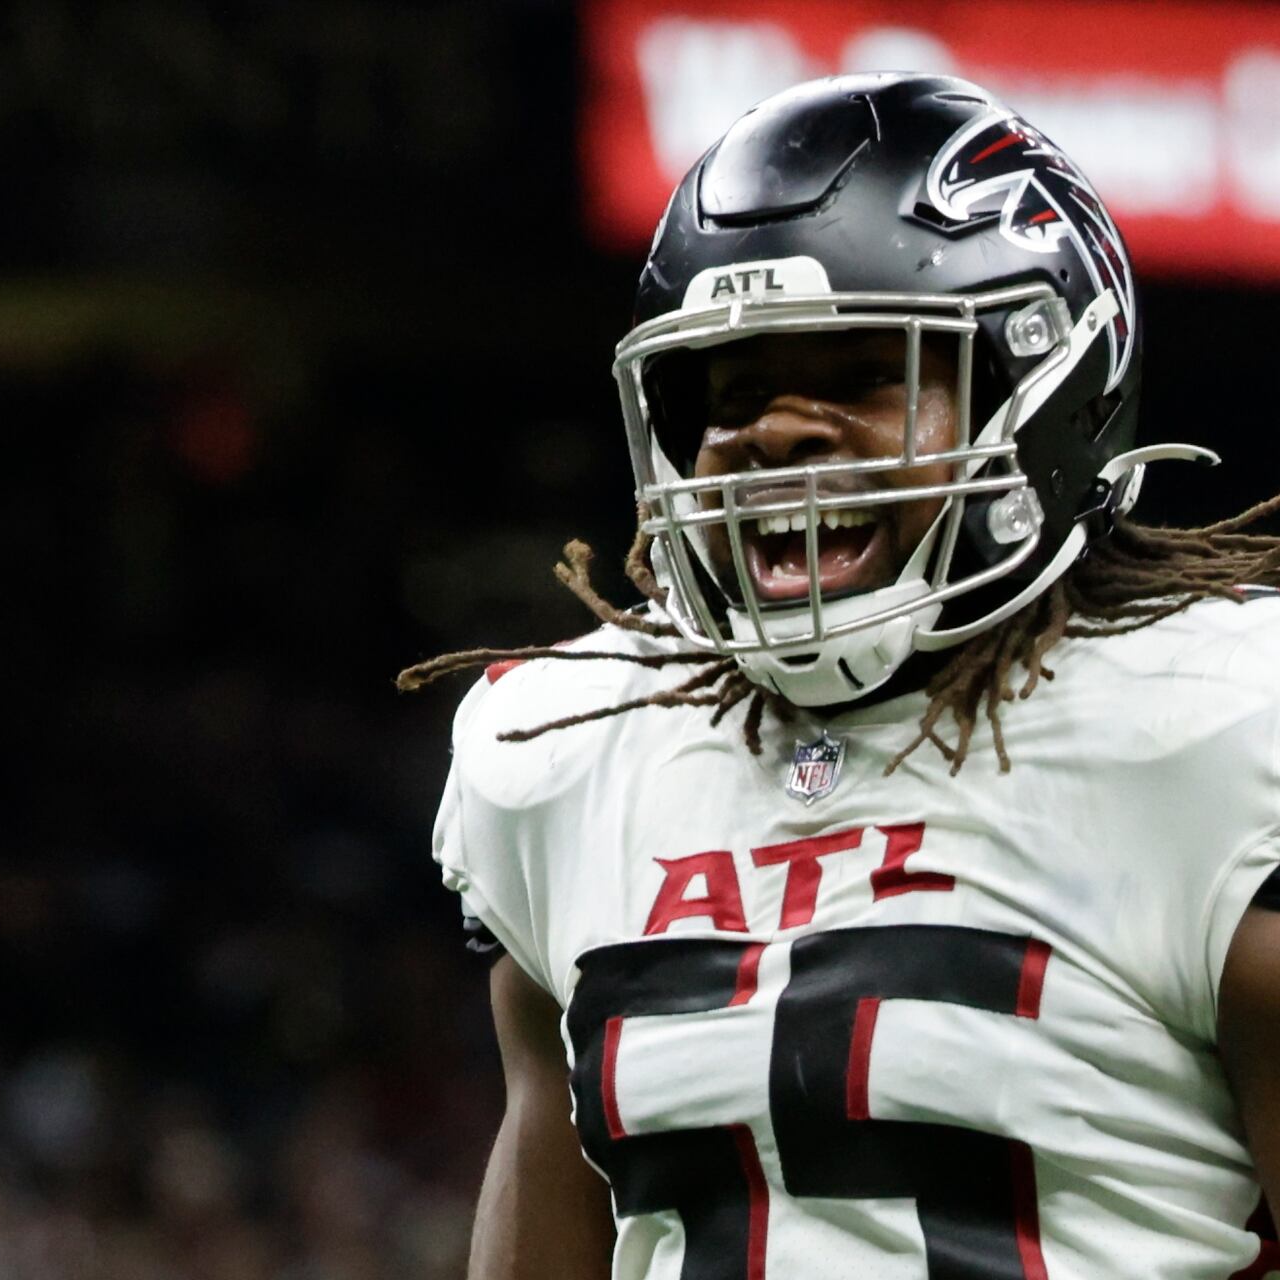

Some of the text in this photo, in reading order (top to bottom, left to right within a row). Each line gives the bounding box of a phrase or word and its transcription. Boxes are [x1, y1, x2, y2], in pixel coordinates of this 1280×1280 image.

[711, 268, 784, 299] ATL
[795, 762, 829, 791] NFL
[643, 821, 956, 936] ATL
